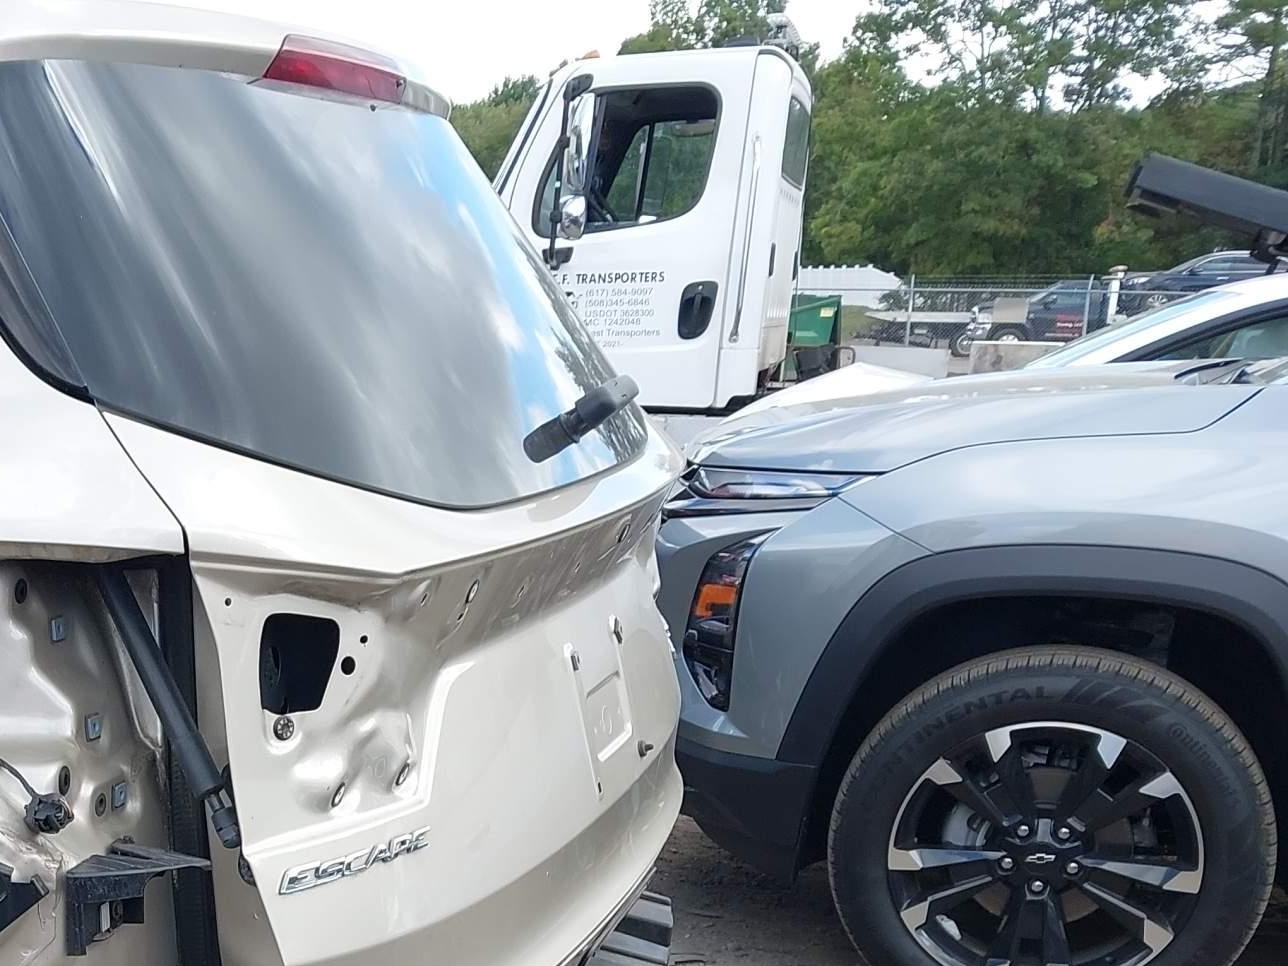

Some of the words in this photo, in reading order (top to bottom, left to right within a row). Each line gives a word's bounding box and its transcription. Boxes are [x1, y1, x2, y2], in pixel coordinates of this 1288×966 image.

[575, 271, 665, 285] TRANSPORTERS
[584, 309, 618, 318] USDOT
[606, 328, 661, 338] Transporters
[277, 825, 432, 896] ESCAPE
